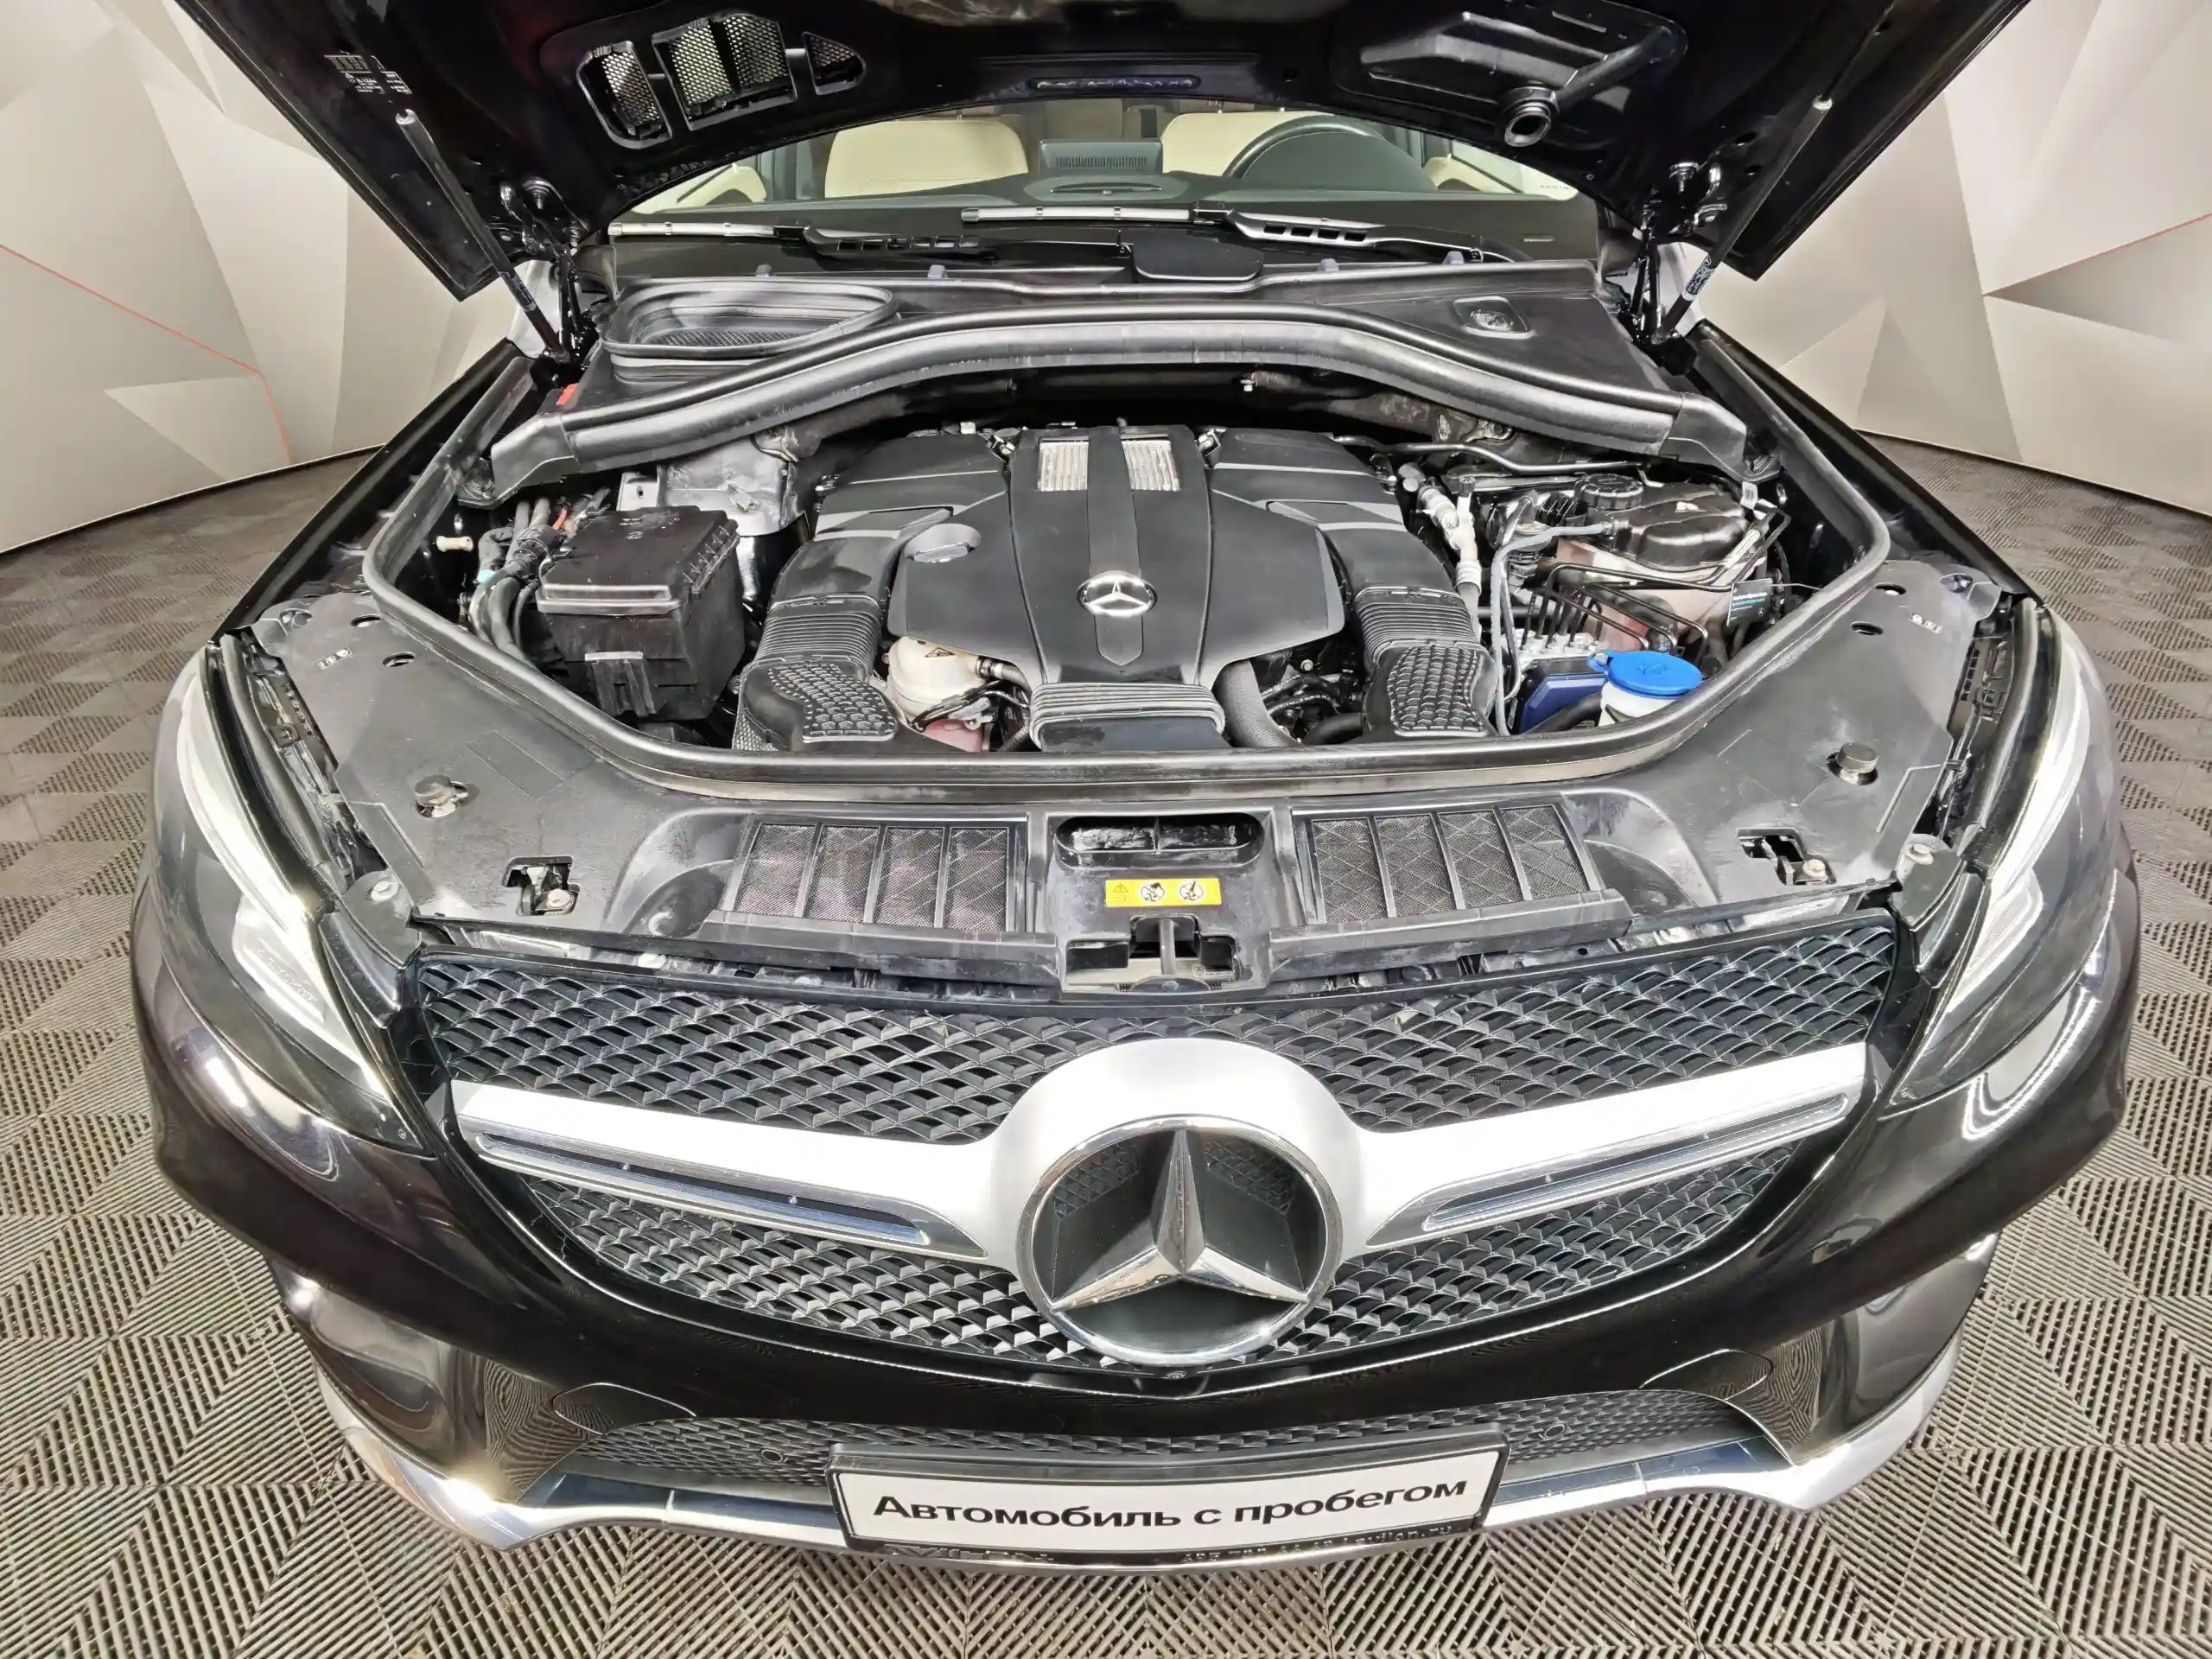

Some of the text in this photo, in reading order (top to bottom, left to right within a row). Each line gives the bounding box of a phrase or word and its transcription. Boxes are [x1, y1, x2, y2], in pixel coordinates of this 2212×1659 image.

[873, 1480, 1468, 1528] Автомобиль с пробегом
